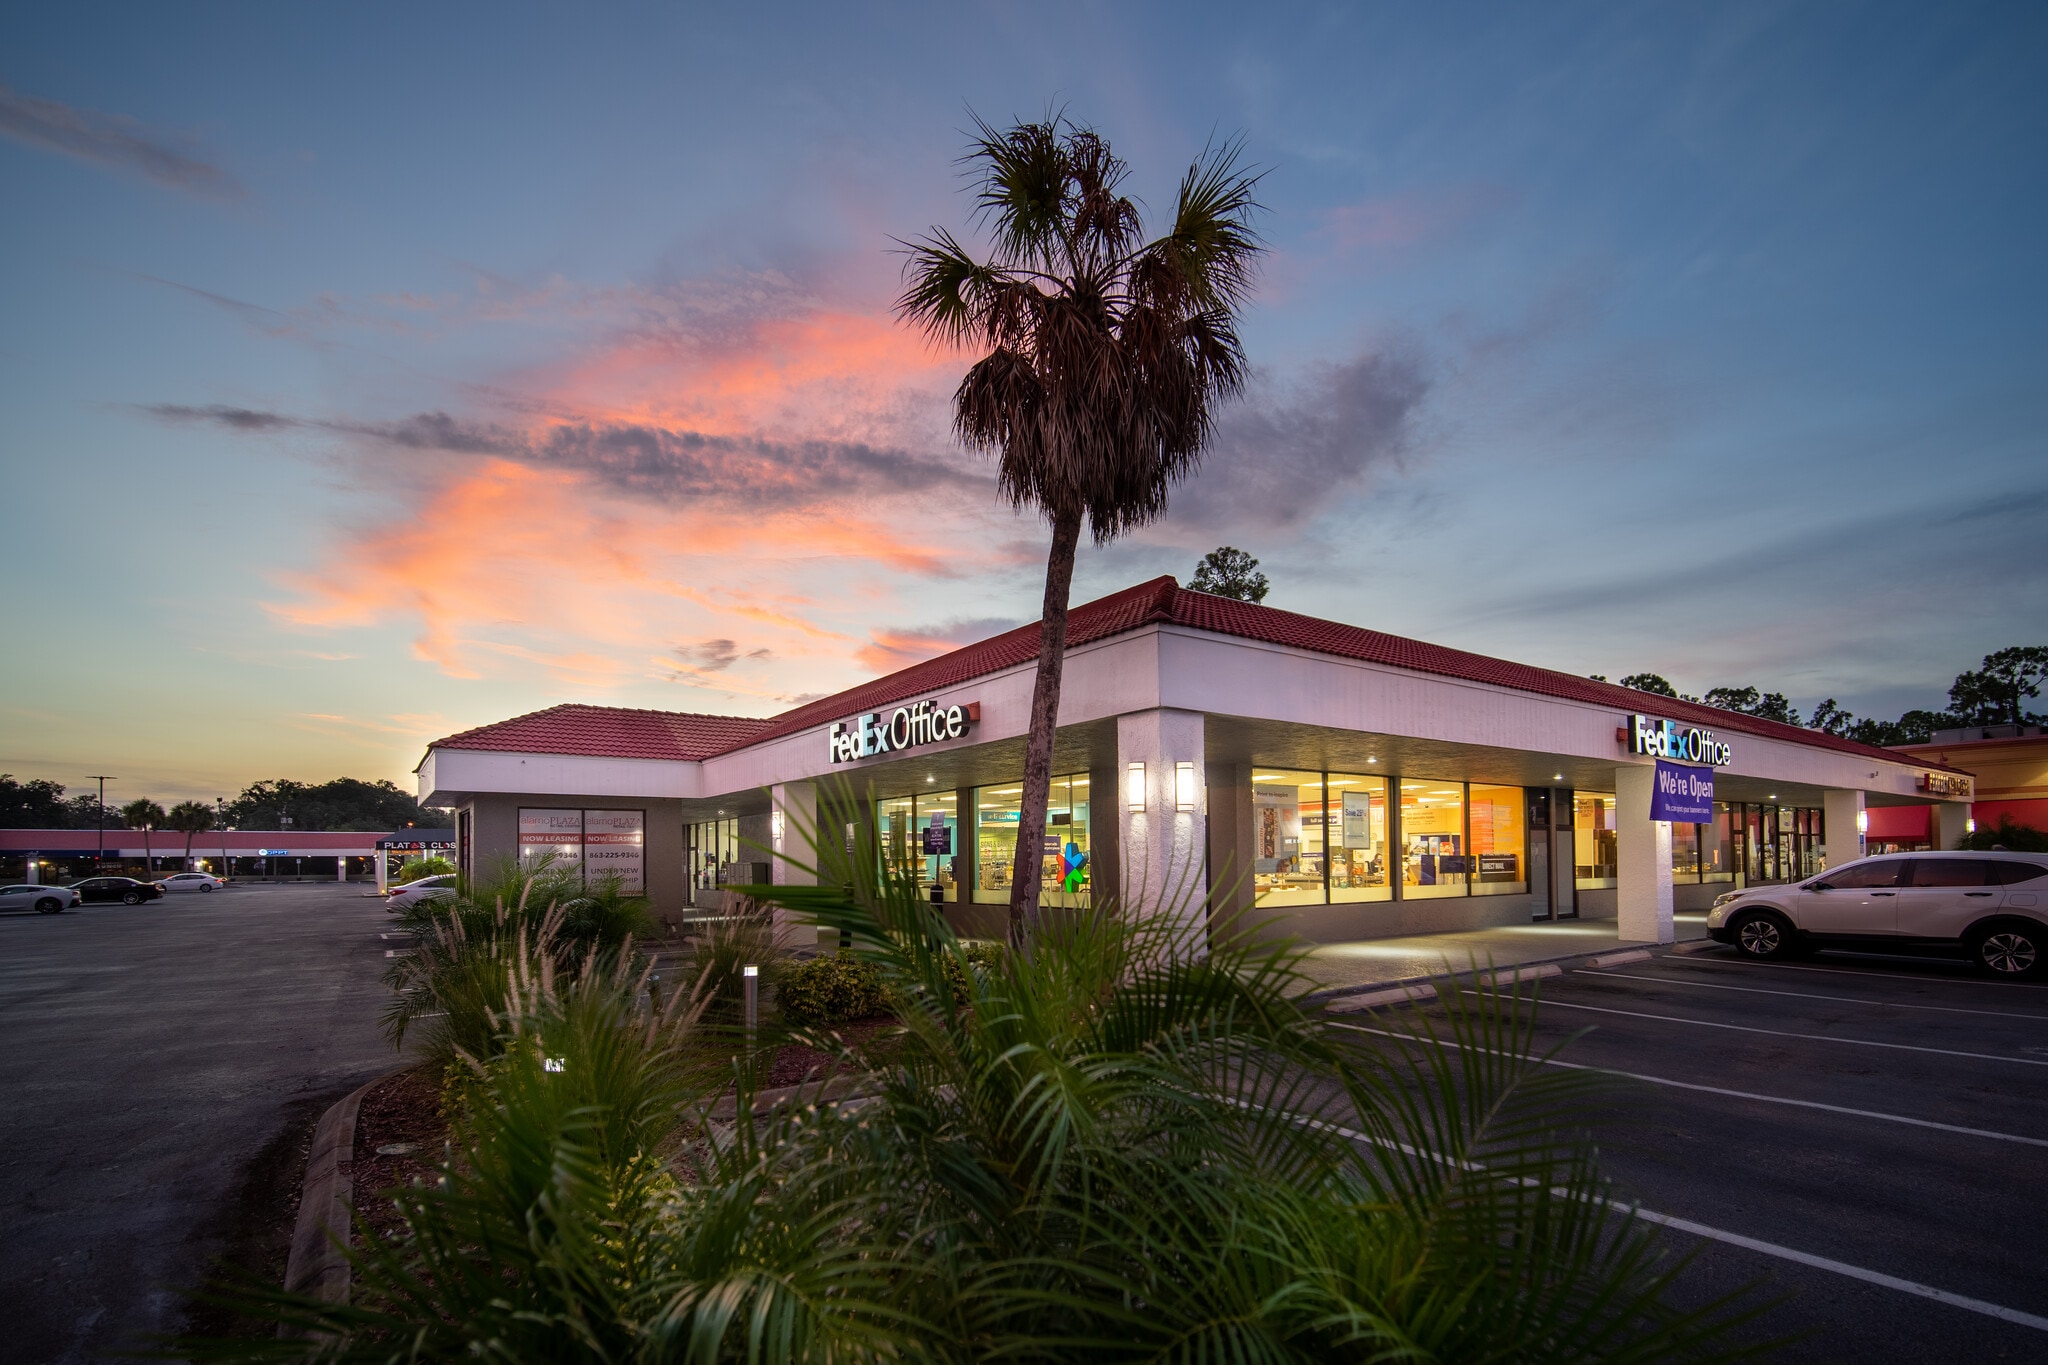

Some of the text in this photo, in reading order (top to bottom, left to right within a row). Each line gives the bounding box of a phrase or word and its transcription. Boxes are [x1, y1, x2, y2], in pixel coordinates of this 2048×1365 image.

[829, 701, 963, 763] FedEx Office
[1635, 714, 1731, 766] FedEx Office
[1659, 770, 1713, 803] We're Open
[1345, 808, 1356, 817] Save
